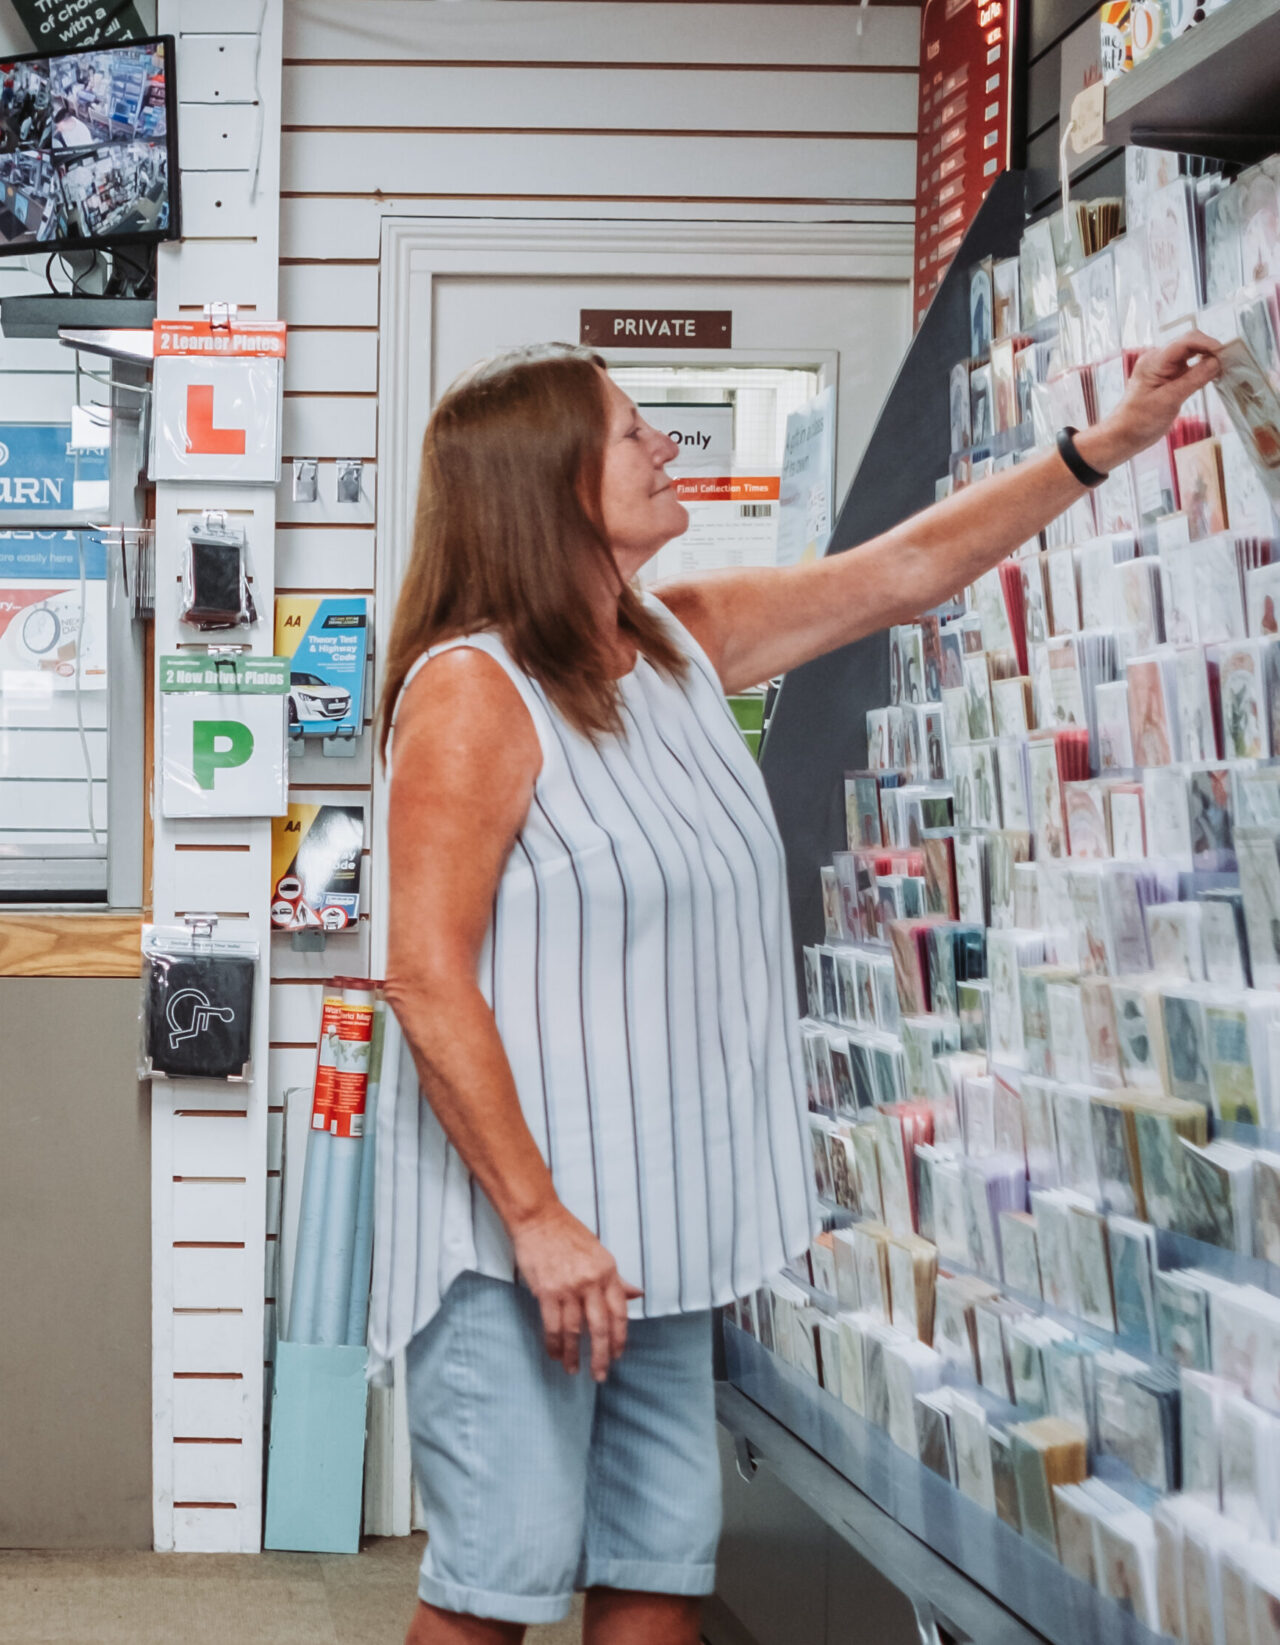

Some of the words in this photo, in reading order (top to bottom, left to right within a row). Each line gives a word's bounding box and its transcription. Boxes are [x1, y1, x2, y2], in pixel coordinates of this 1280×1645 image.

[40, 14, 56, 33] of
[59, 16, 94, 42] with
[95, 7, 107, 20] a
[613, 319, 696, 336] PRIVATE
[160, 333, 171, 350] 2
[173, 333, 231, 351] Learner
[233, 335, 279, 352] Plates
[186, 384, 246, 454] L
[667, 430, 711, 449] Only
[677, 484, 698, 493] Final
[700, 484, 741, 493] Collection
[744, 483, 769, 492] Times
[17, 552, 47, 564] easily
[50, 552, 73, 563] here
[283, 615, 301, 627] AA
[166, 670, 174, 683] 2
[177, 670, 203, 683] New
[205, 670, 242, 684] Driver
[245, 671, 284, 685] Plates
[193, 720, 254, 790] P
[284, 820, 301, 832] AA
[333, 860, 356, 870] ode
